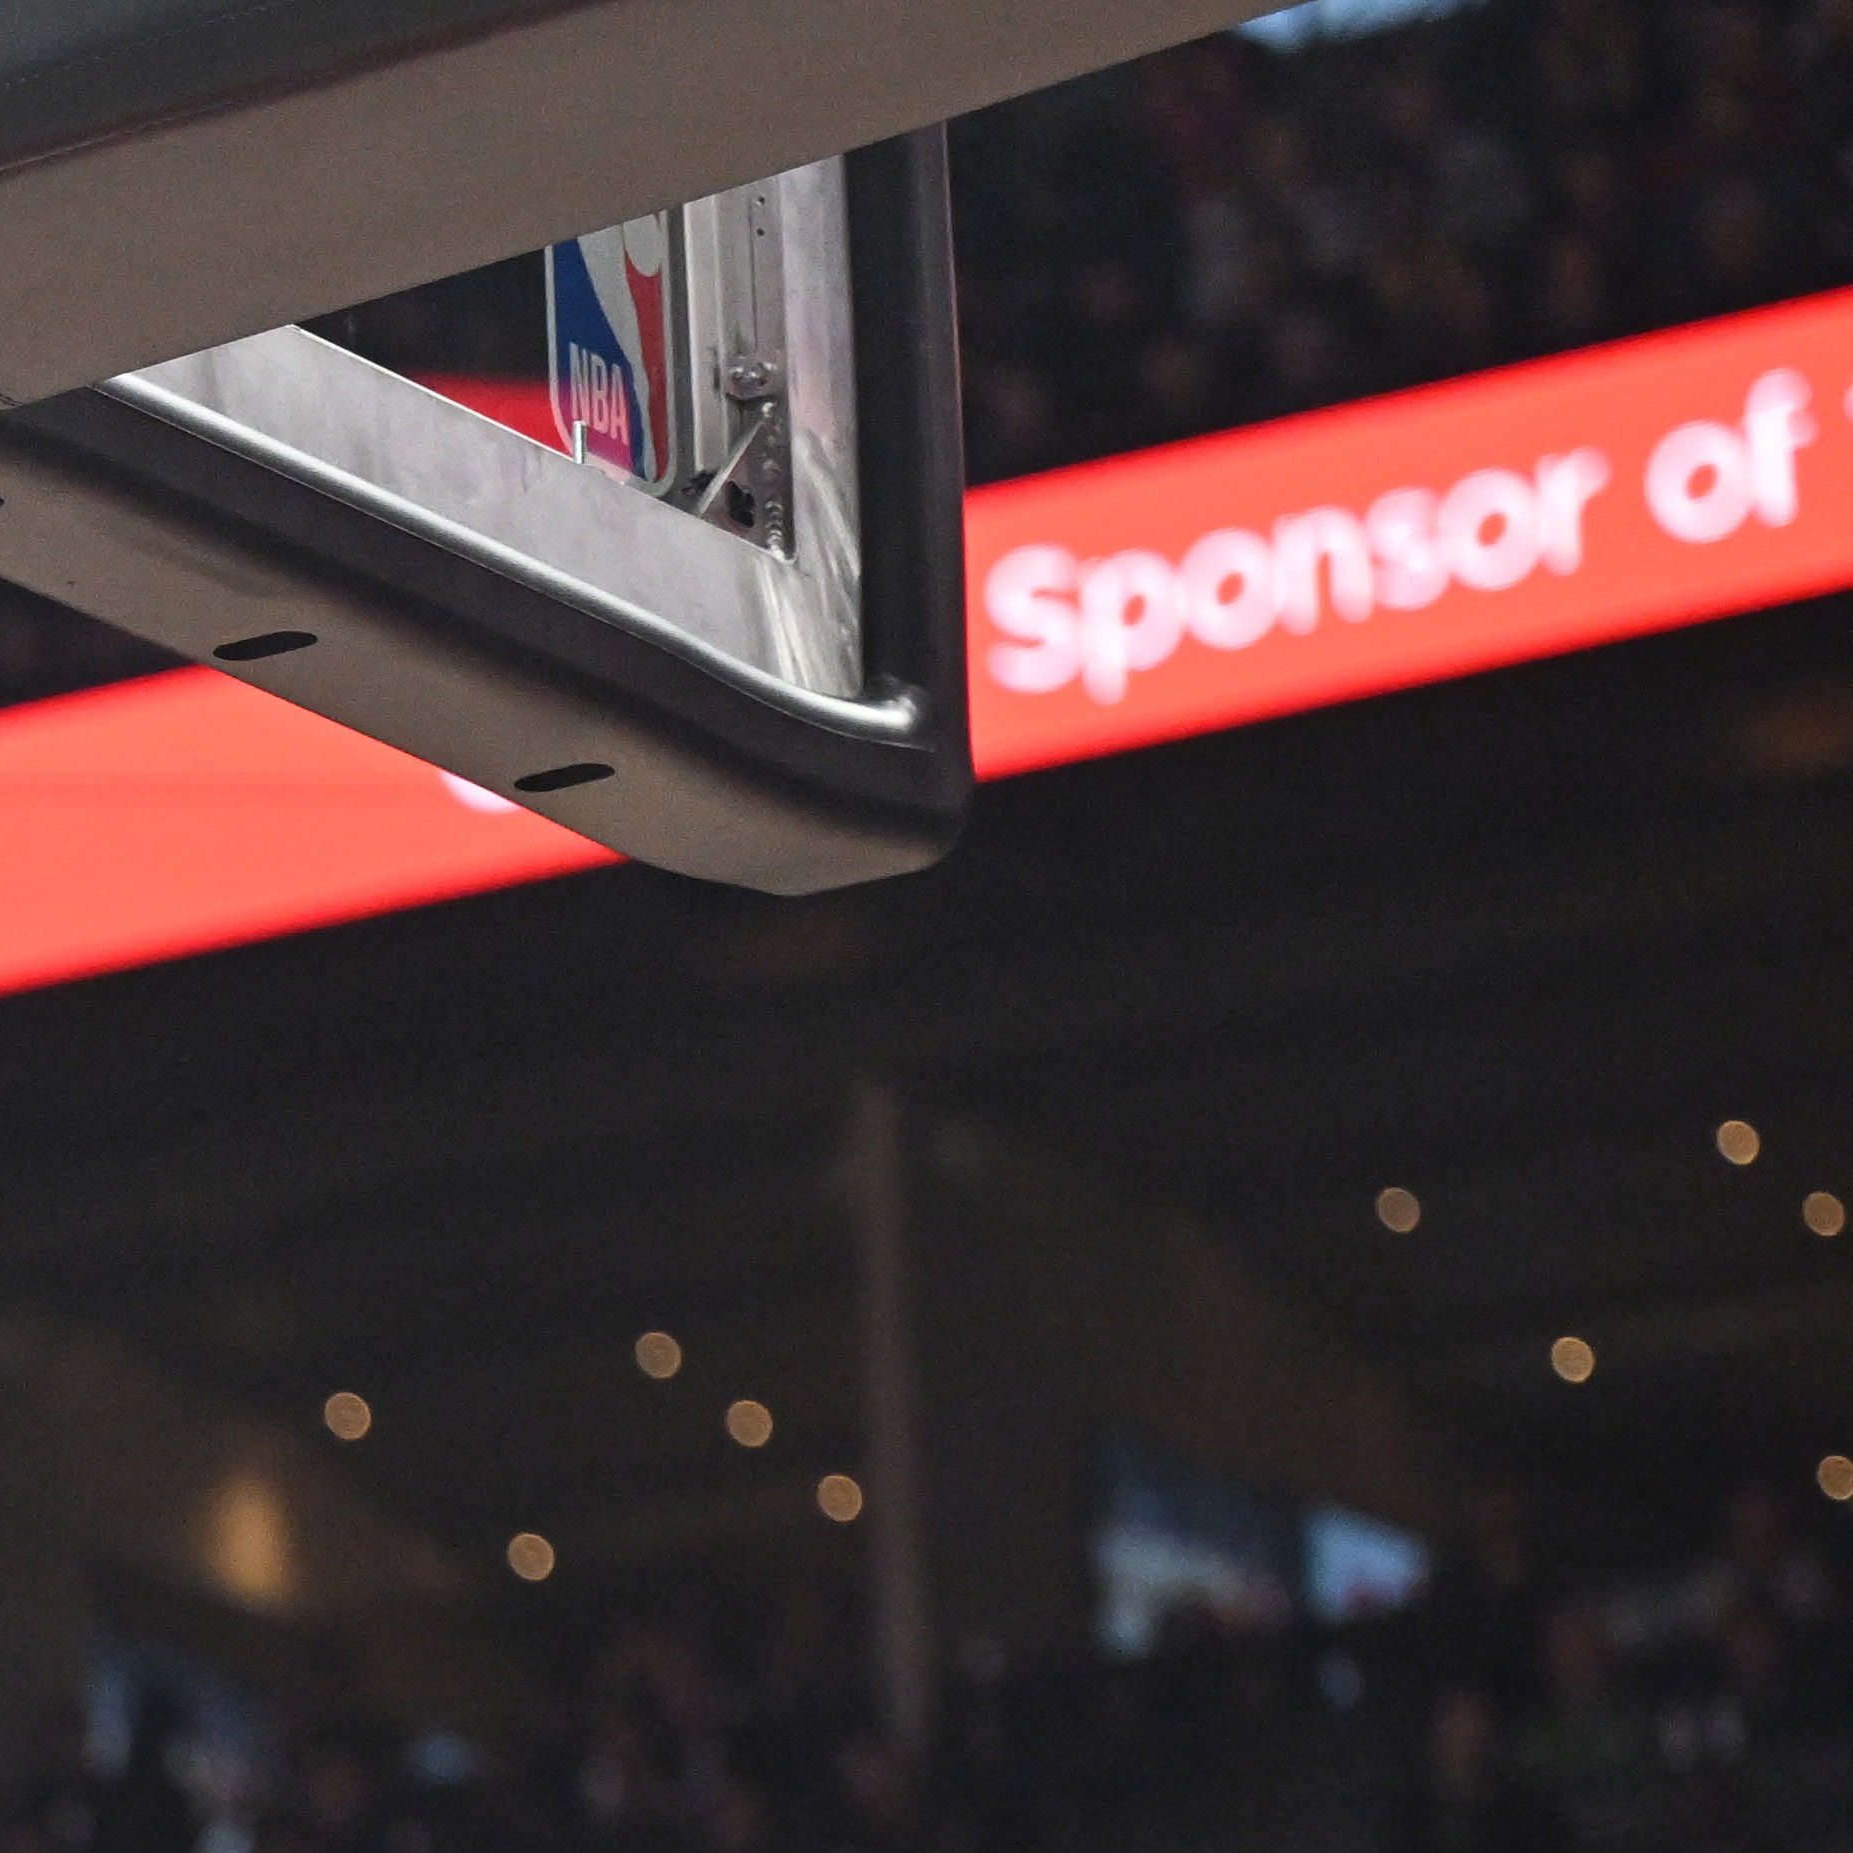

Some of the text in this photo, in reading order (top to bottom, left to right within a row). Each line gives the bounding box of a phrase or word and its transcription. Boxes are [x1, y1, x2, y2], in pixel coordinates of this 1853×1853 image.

[569, 341, 629, 446] NBA
[985, 367, 1820, 704] Sponsor of
